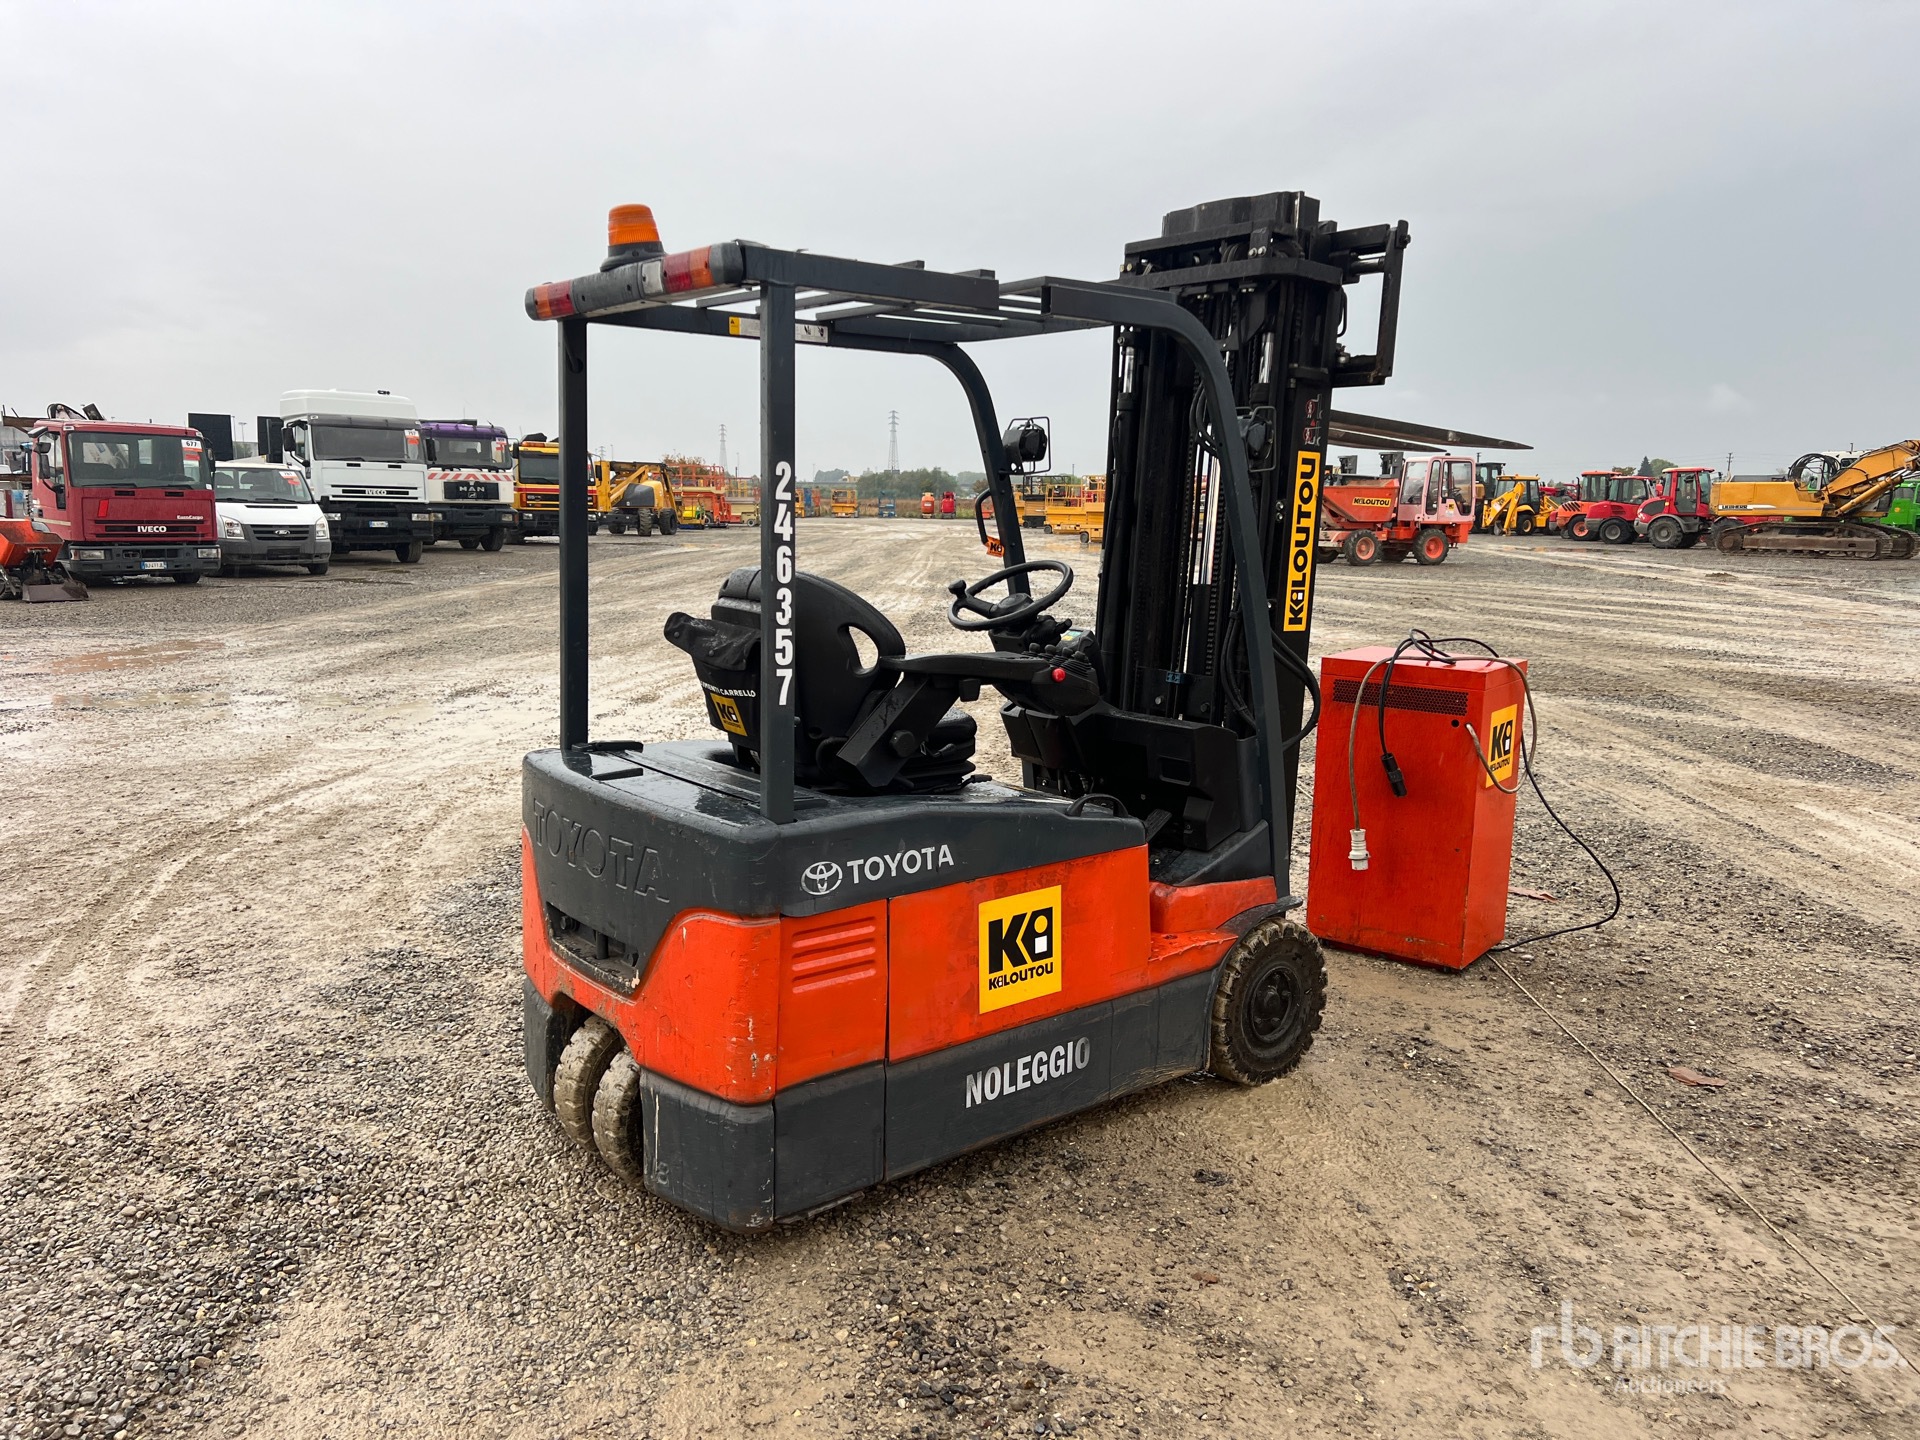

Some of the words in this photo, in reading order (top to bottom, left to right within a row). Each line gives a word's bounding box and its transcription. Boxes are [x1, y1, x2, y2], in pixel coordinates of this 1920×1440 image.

[137, 525, 167, 533] IVECO
[720, 689, 756, 698] CARRELLO
[534, 798, 670, 903] TOYOTA
[847, 844, 954, 884] TOYOTA
[965, 1037, 1090, 1109] NOLEGGIO
